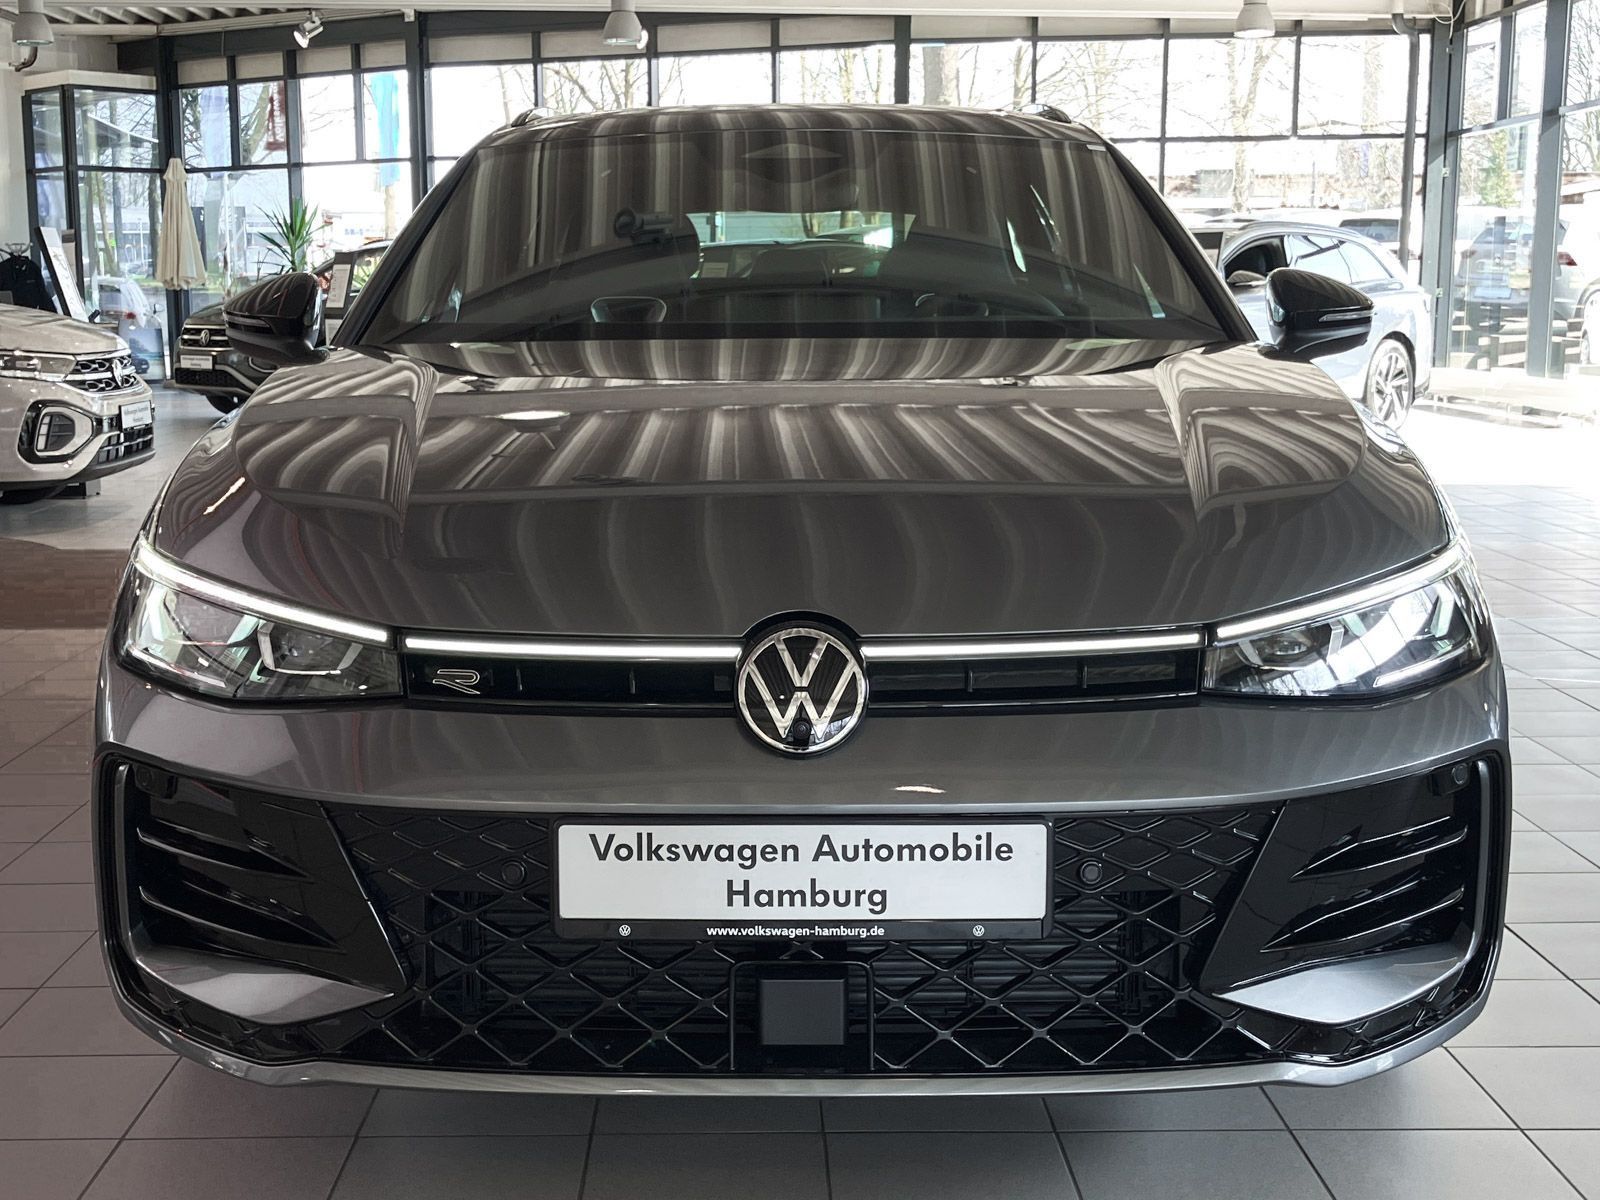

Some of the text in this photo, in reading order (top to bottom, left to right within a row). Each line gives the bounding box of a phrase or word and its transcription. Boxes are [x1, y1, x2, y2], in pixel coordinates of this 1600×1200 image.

[589, 832, 1013, 869] Volkswagen Automobile
[727, 878, 887, 914] Hamburg
[707, 926, 884, 938] www.volkswagen-hamburg.de
